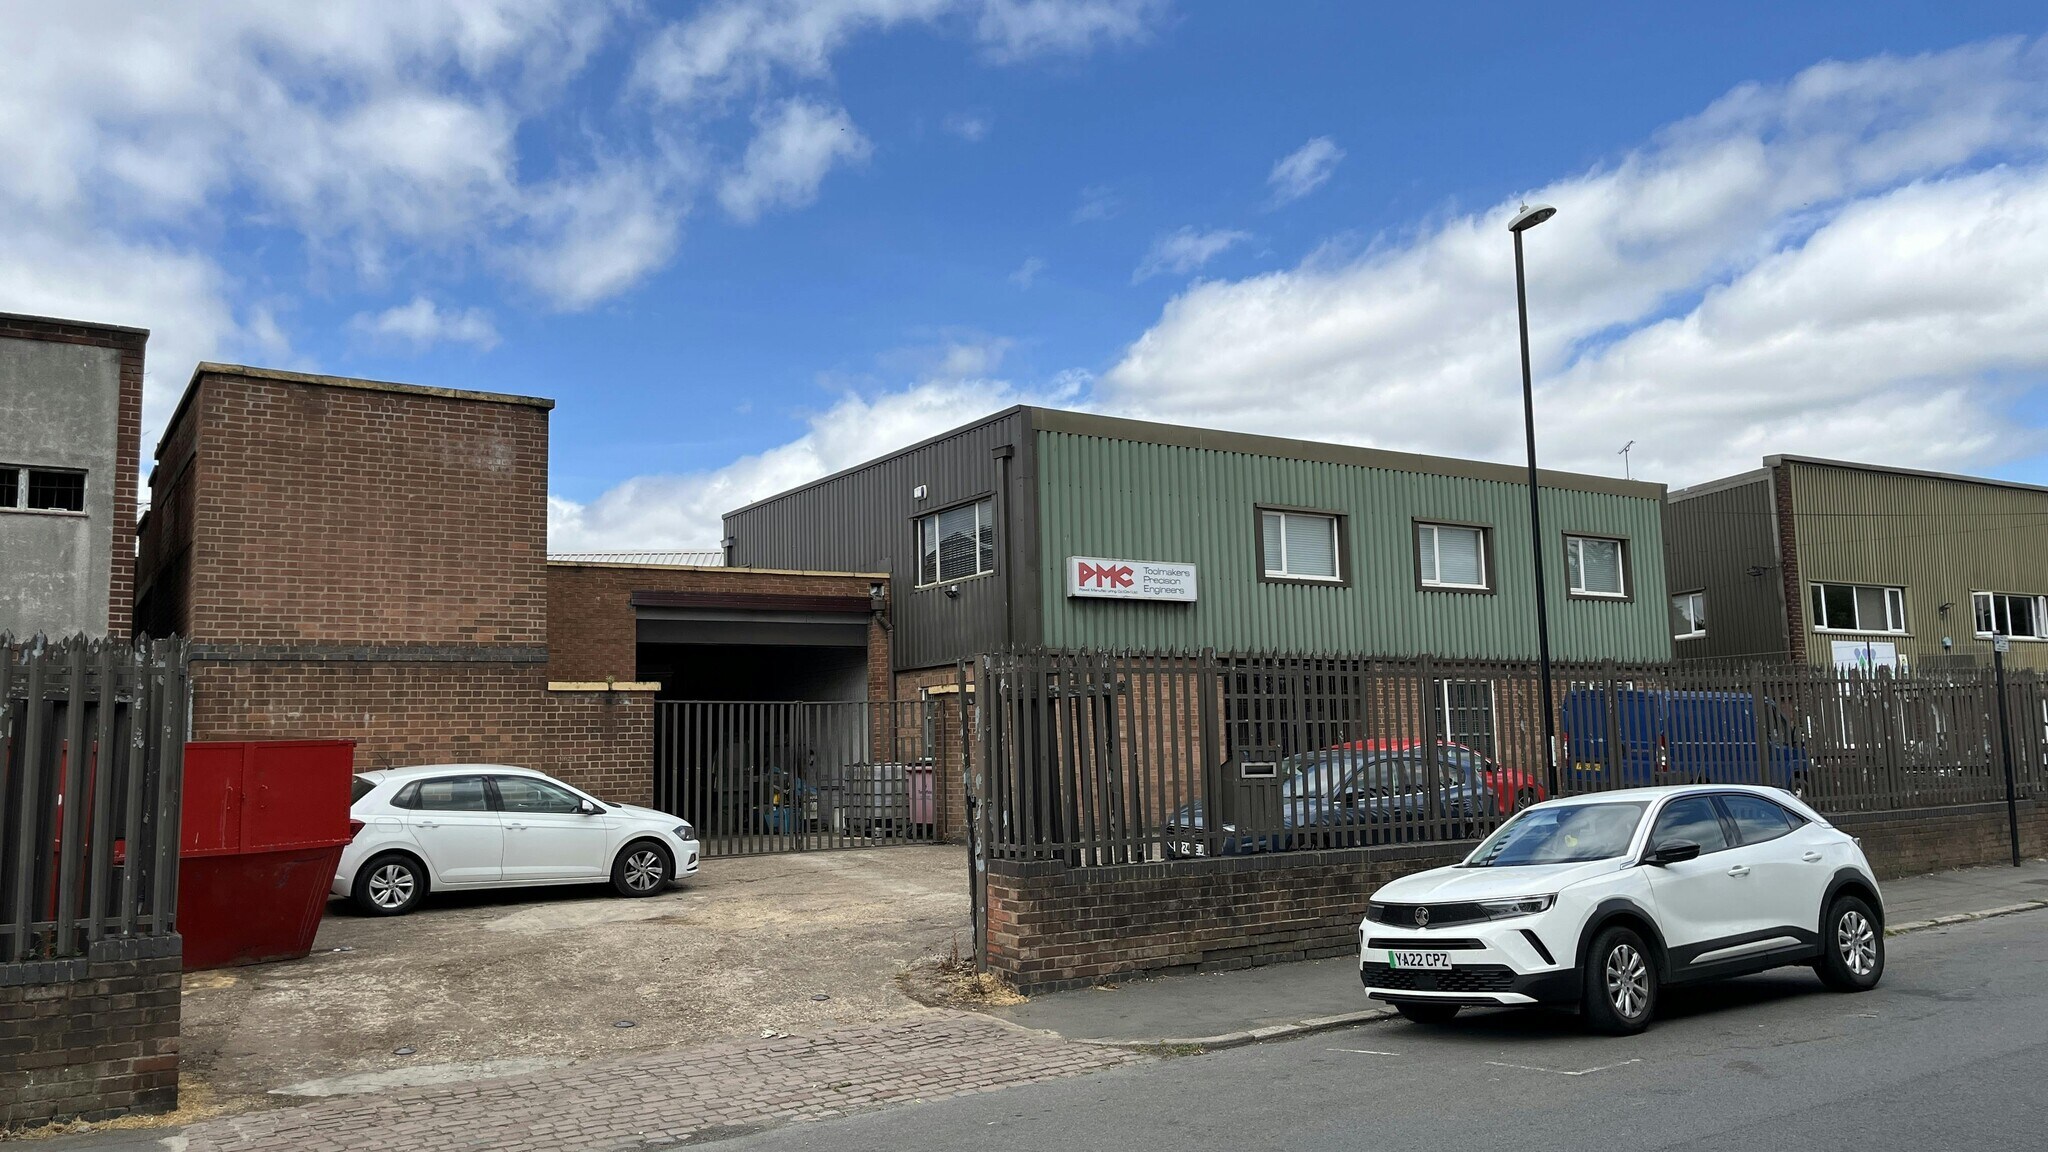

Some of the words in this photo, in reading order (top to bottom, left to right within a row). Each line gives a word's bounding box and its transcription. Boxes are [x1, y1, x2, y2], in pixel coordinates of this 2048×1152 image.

[1078, 562, 1134, 588] PMC
[1143, 566, 1190, 577] Toolmakers
[1143, 575, 1181, 585] Precision
[1143, 585, 1185, 595] Engineers
[1395, 953, 1424, 967] YA22
[1425, 953, 1449, 967] CPZ
